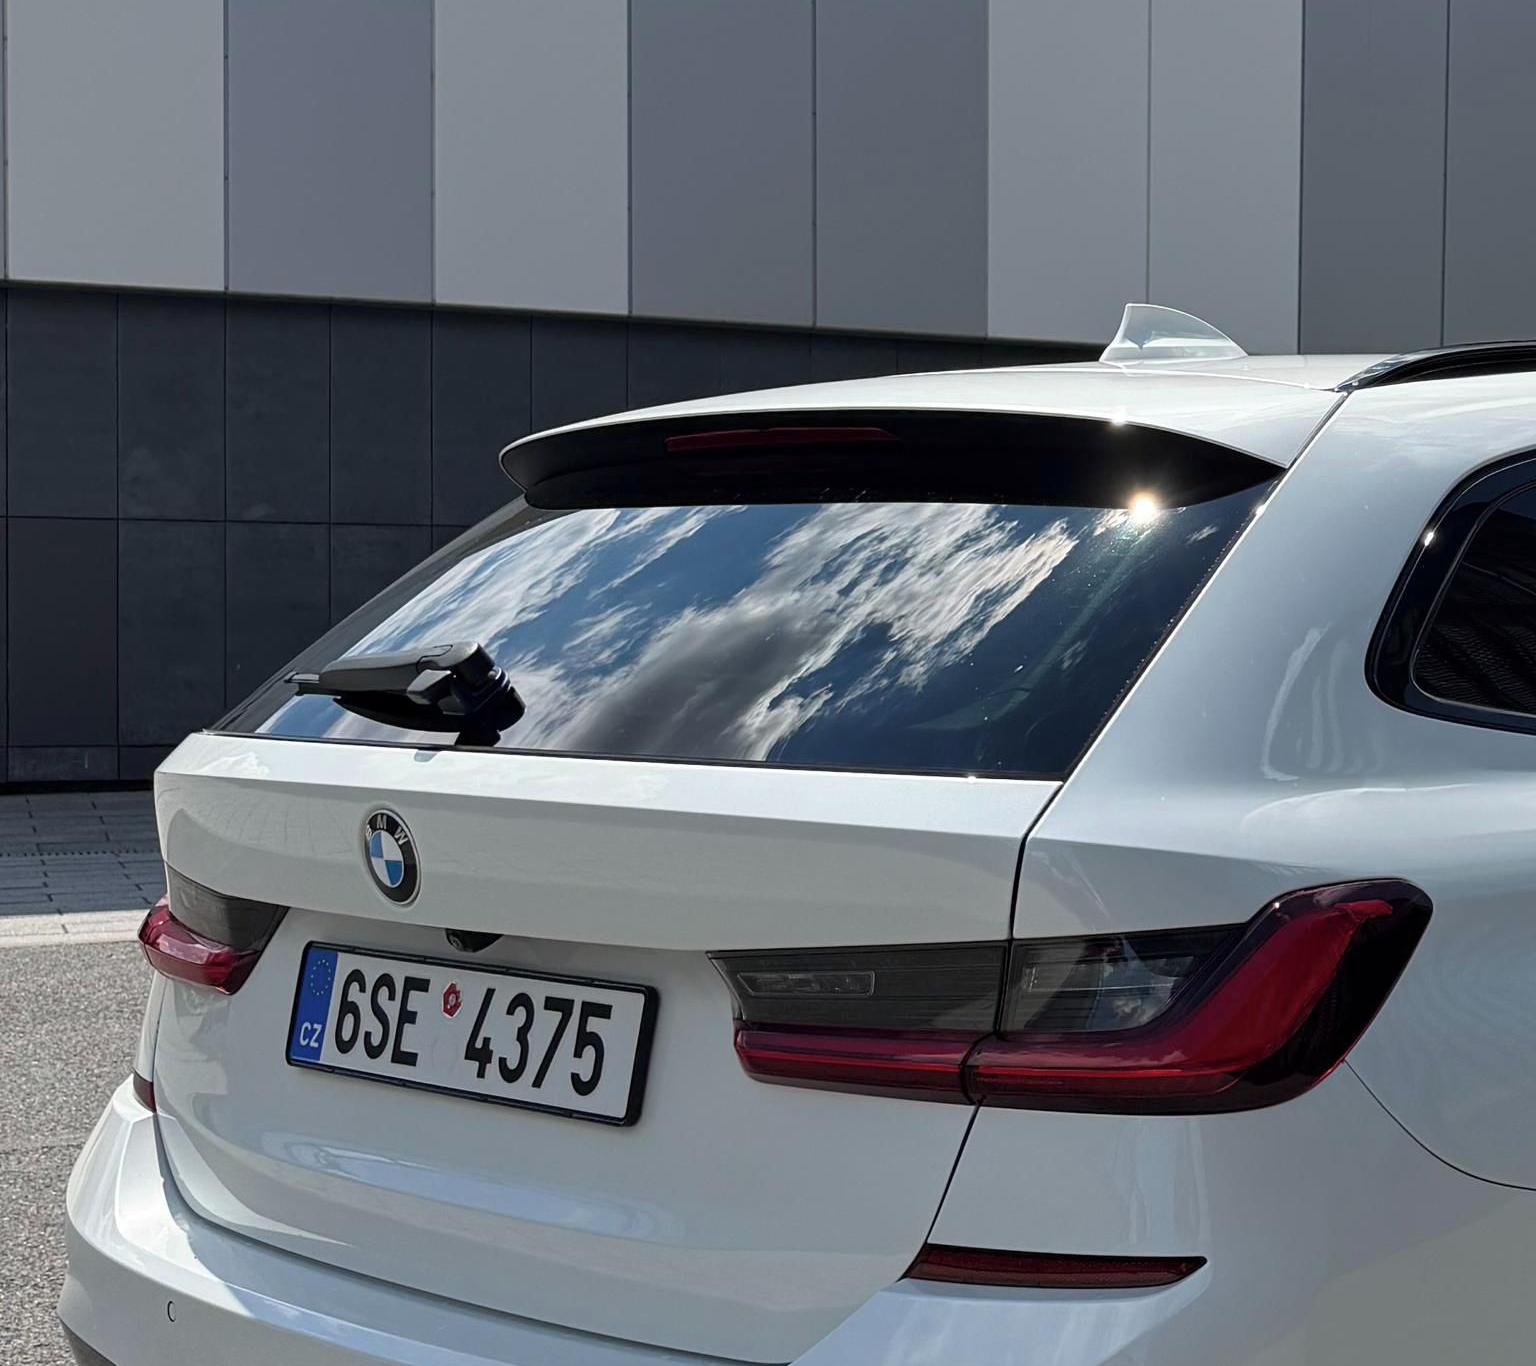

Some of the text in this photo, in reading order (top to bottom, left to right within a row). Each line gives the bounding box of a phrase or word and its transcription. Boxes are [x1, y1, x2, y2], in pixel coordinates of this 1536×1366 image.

[300, 1021, 322, 1048] CZ
[334, 968, 613, 1097] 6SE 4375
